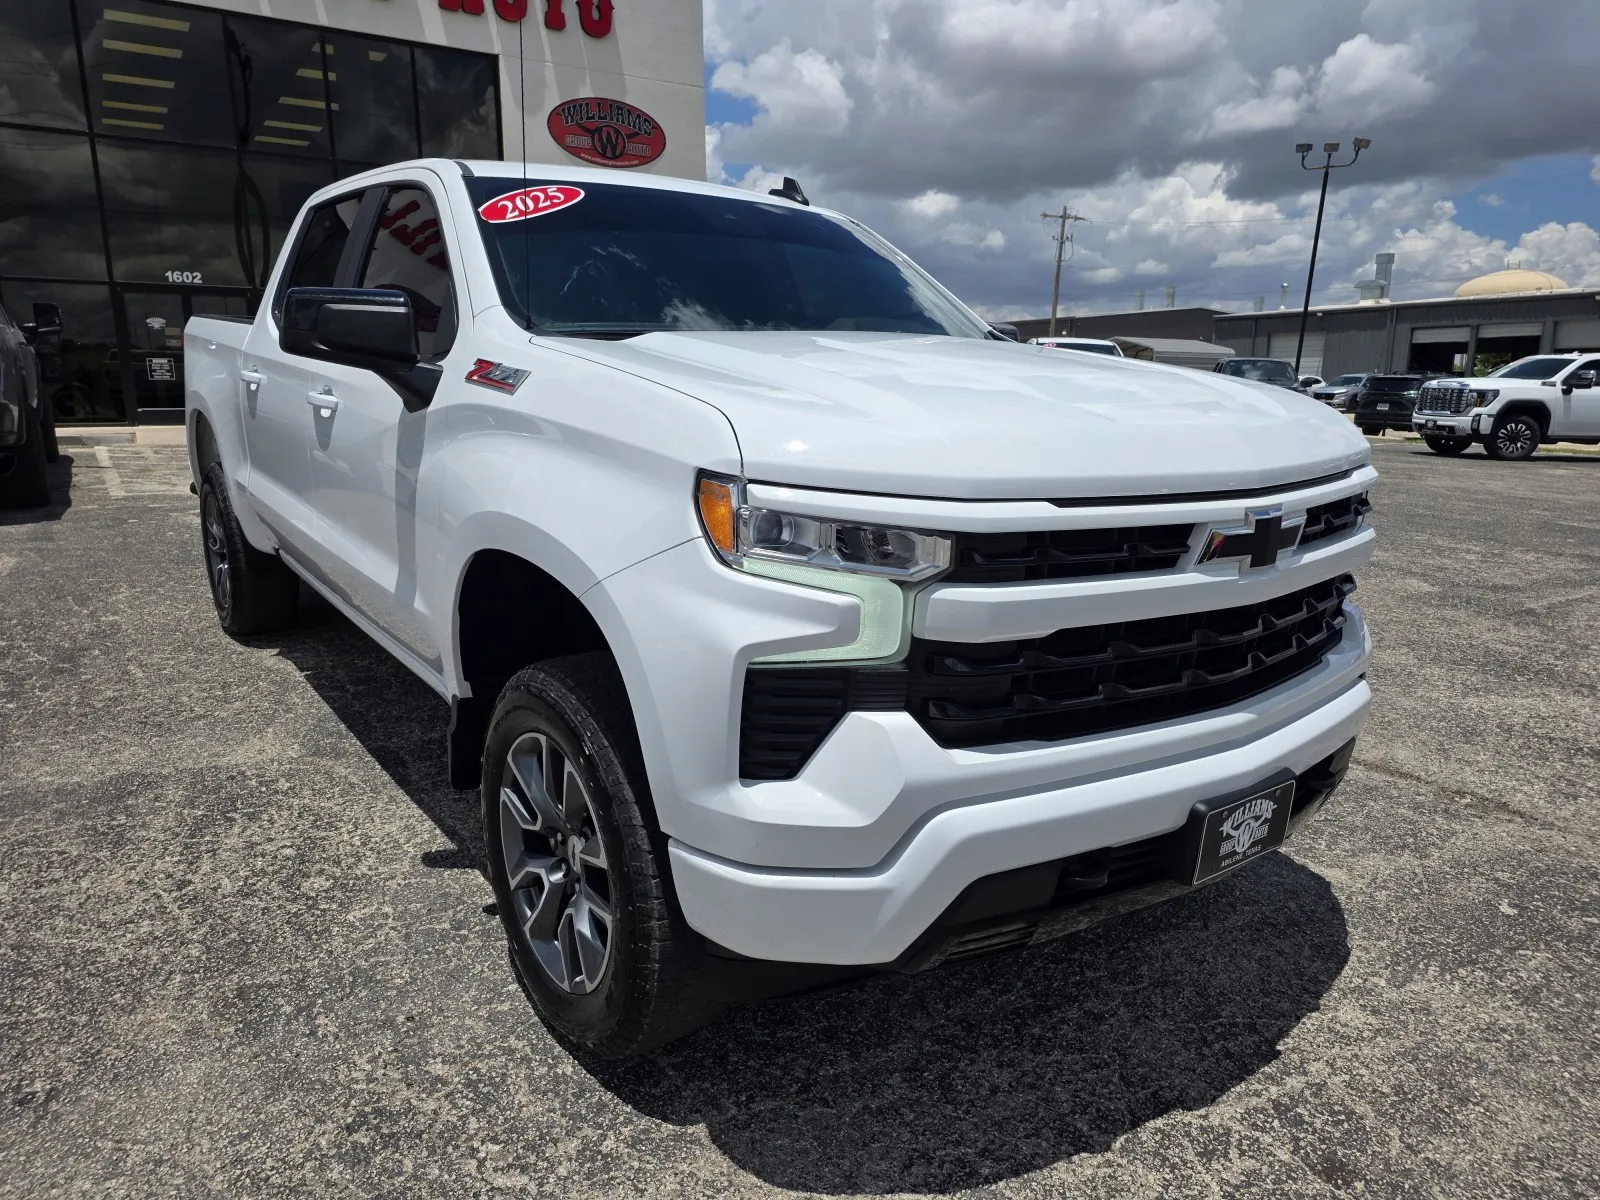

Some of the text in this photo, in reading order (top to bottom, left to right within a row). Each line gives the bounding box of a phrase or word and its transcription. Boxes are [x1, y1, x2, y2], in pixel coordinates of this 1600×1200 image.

[561, 101, 652, 137] WILLIAMS
[565, 134, 651, 157] GROUP AUTO
[598, 127, 620, 158] W
[497, 187, 565, 219] 2025
[165, 270, 203, 284] 1602
[465, 357, 532, 396] Z71
[1222, 799, 1274, 838] WILLIAMS
